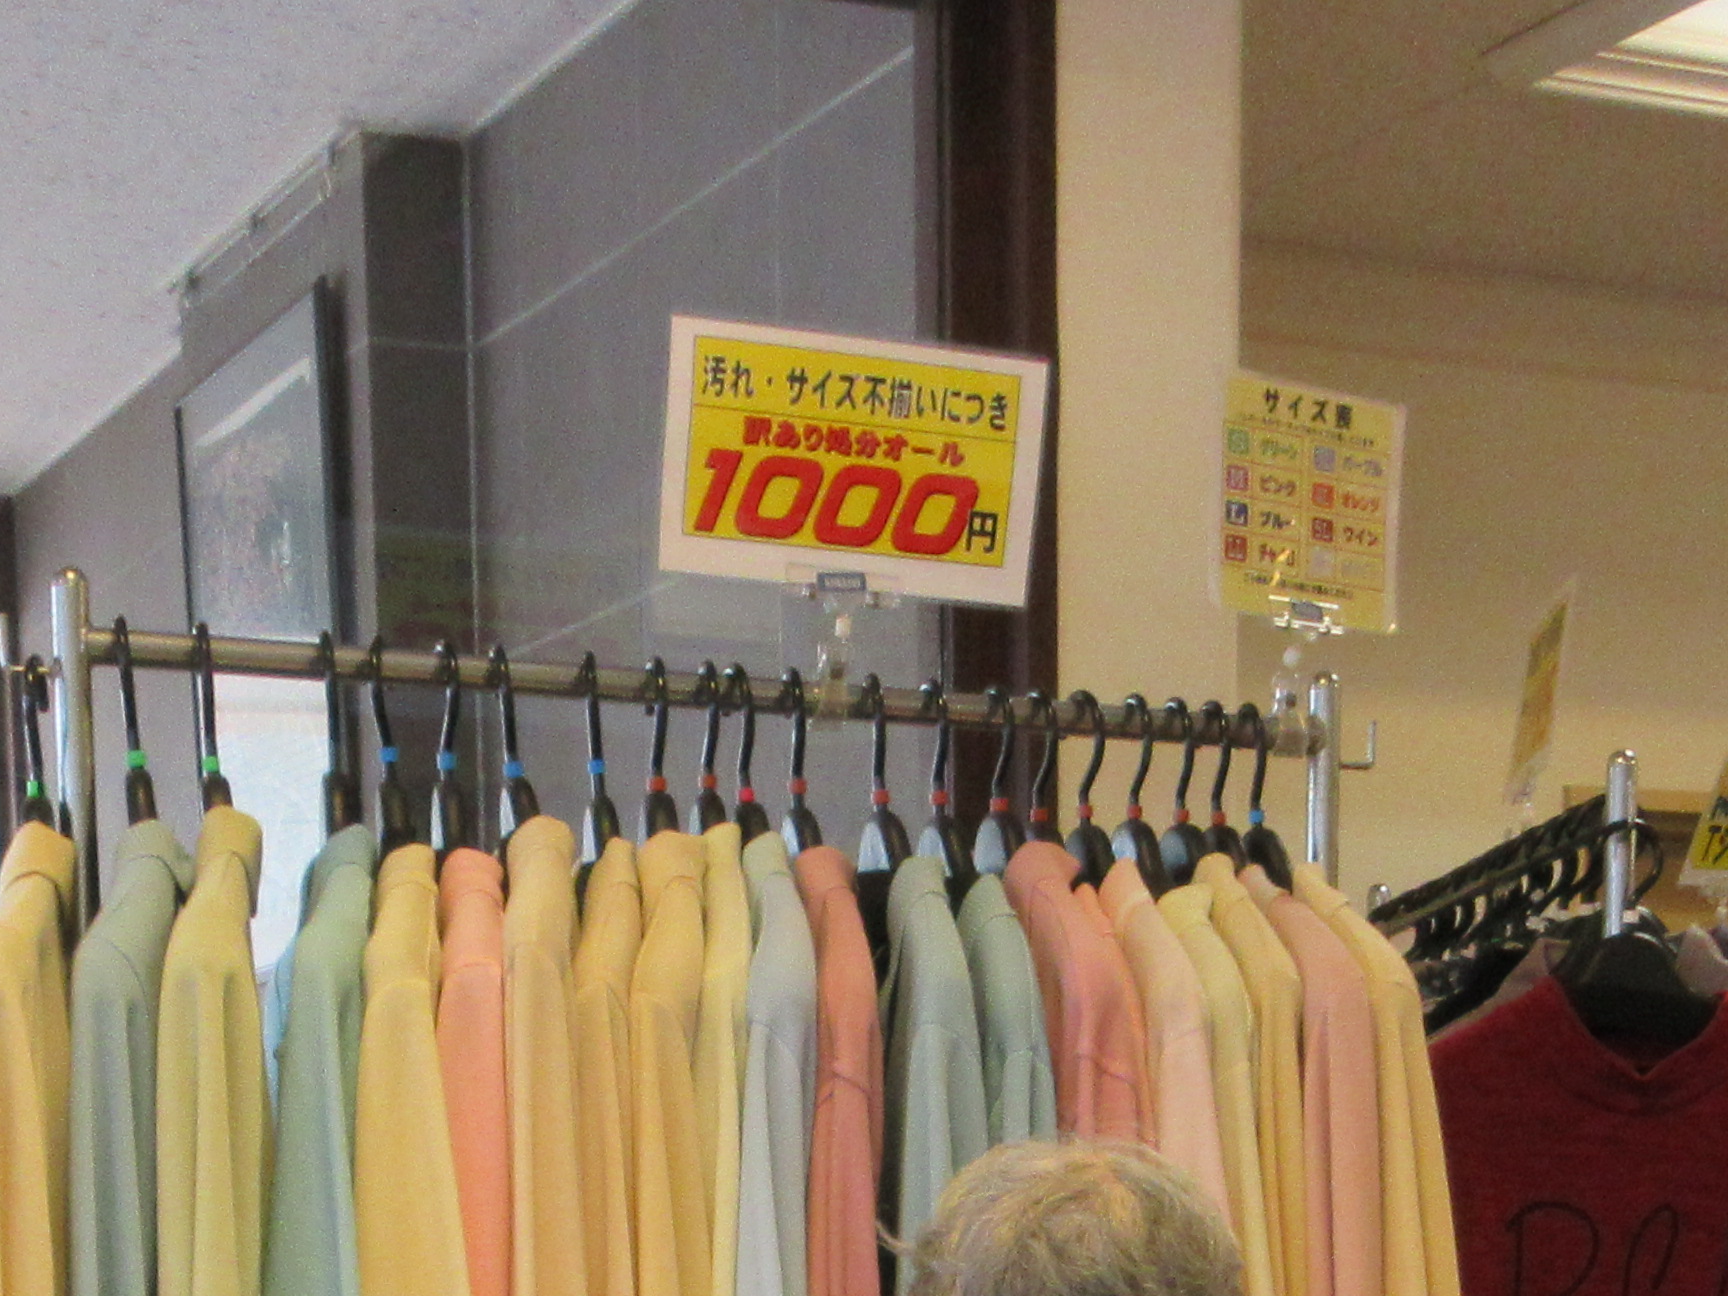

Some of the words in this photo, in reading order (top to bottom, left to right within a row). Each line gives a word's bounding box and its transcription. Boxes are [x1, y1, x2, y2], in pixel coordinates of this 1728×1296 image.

[700, 353, 1010, 432] 汚れ・サイズ不揃いにつき
[742, 415, 966, 467] 訳あり処分オール
